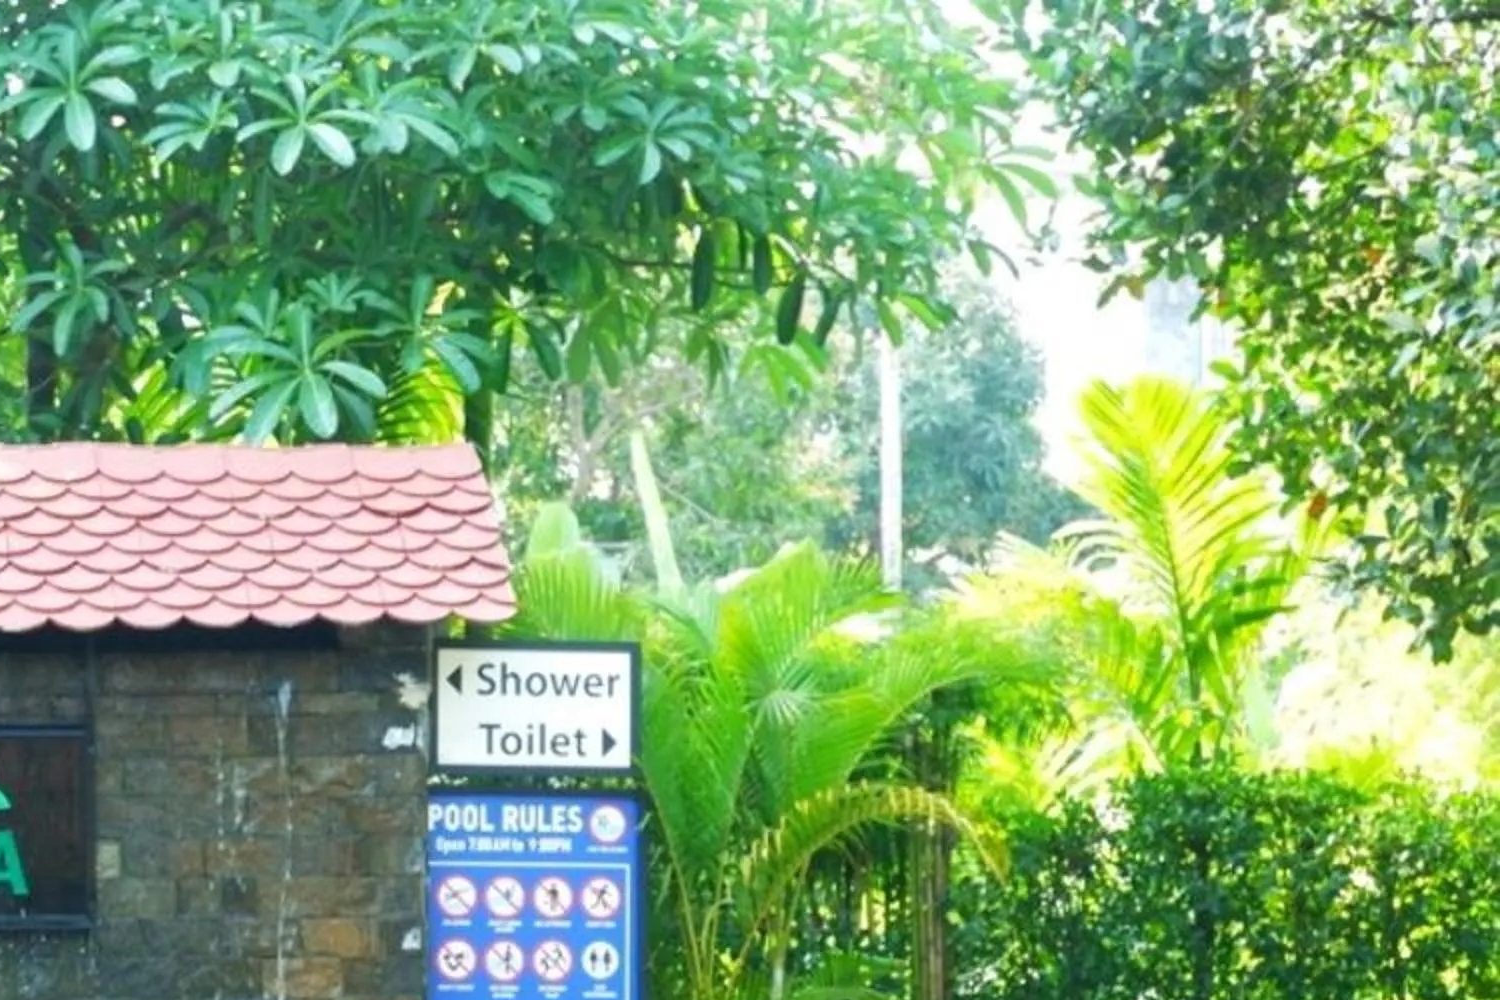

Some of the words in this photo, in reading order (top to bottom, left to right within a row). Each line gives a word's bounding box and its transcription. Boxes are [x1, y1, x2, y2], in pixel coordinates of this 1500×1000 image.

[476, 661, 620, 698] Shower
[478, 722, 587, 757] Toilet
[428, 803, 495, 833] POOL
[502, 804, 584, 834] RULES
